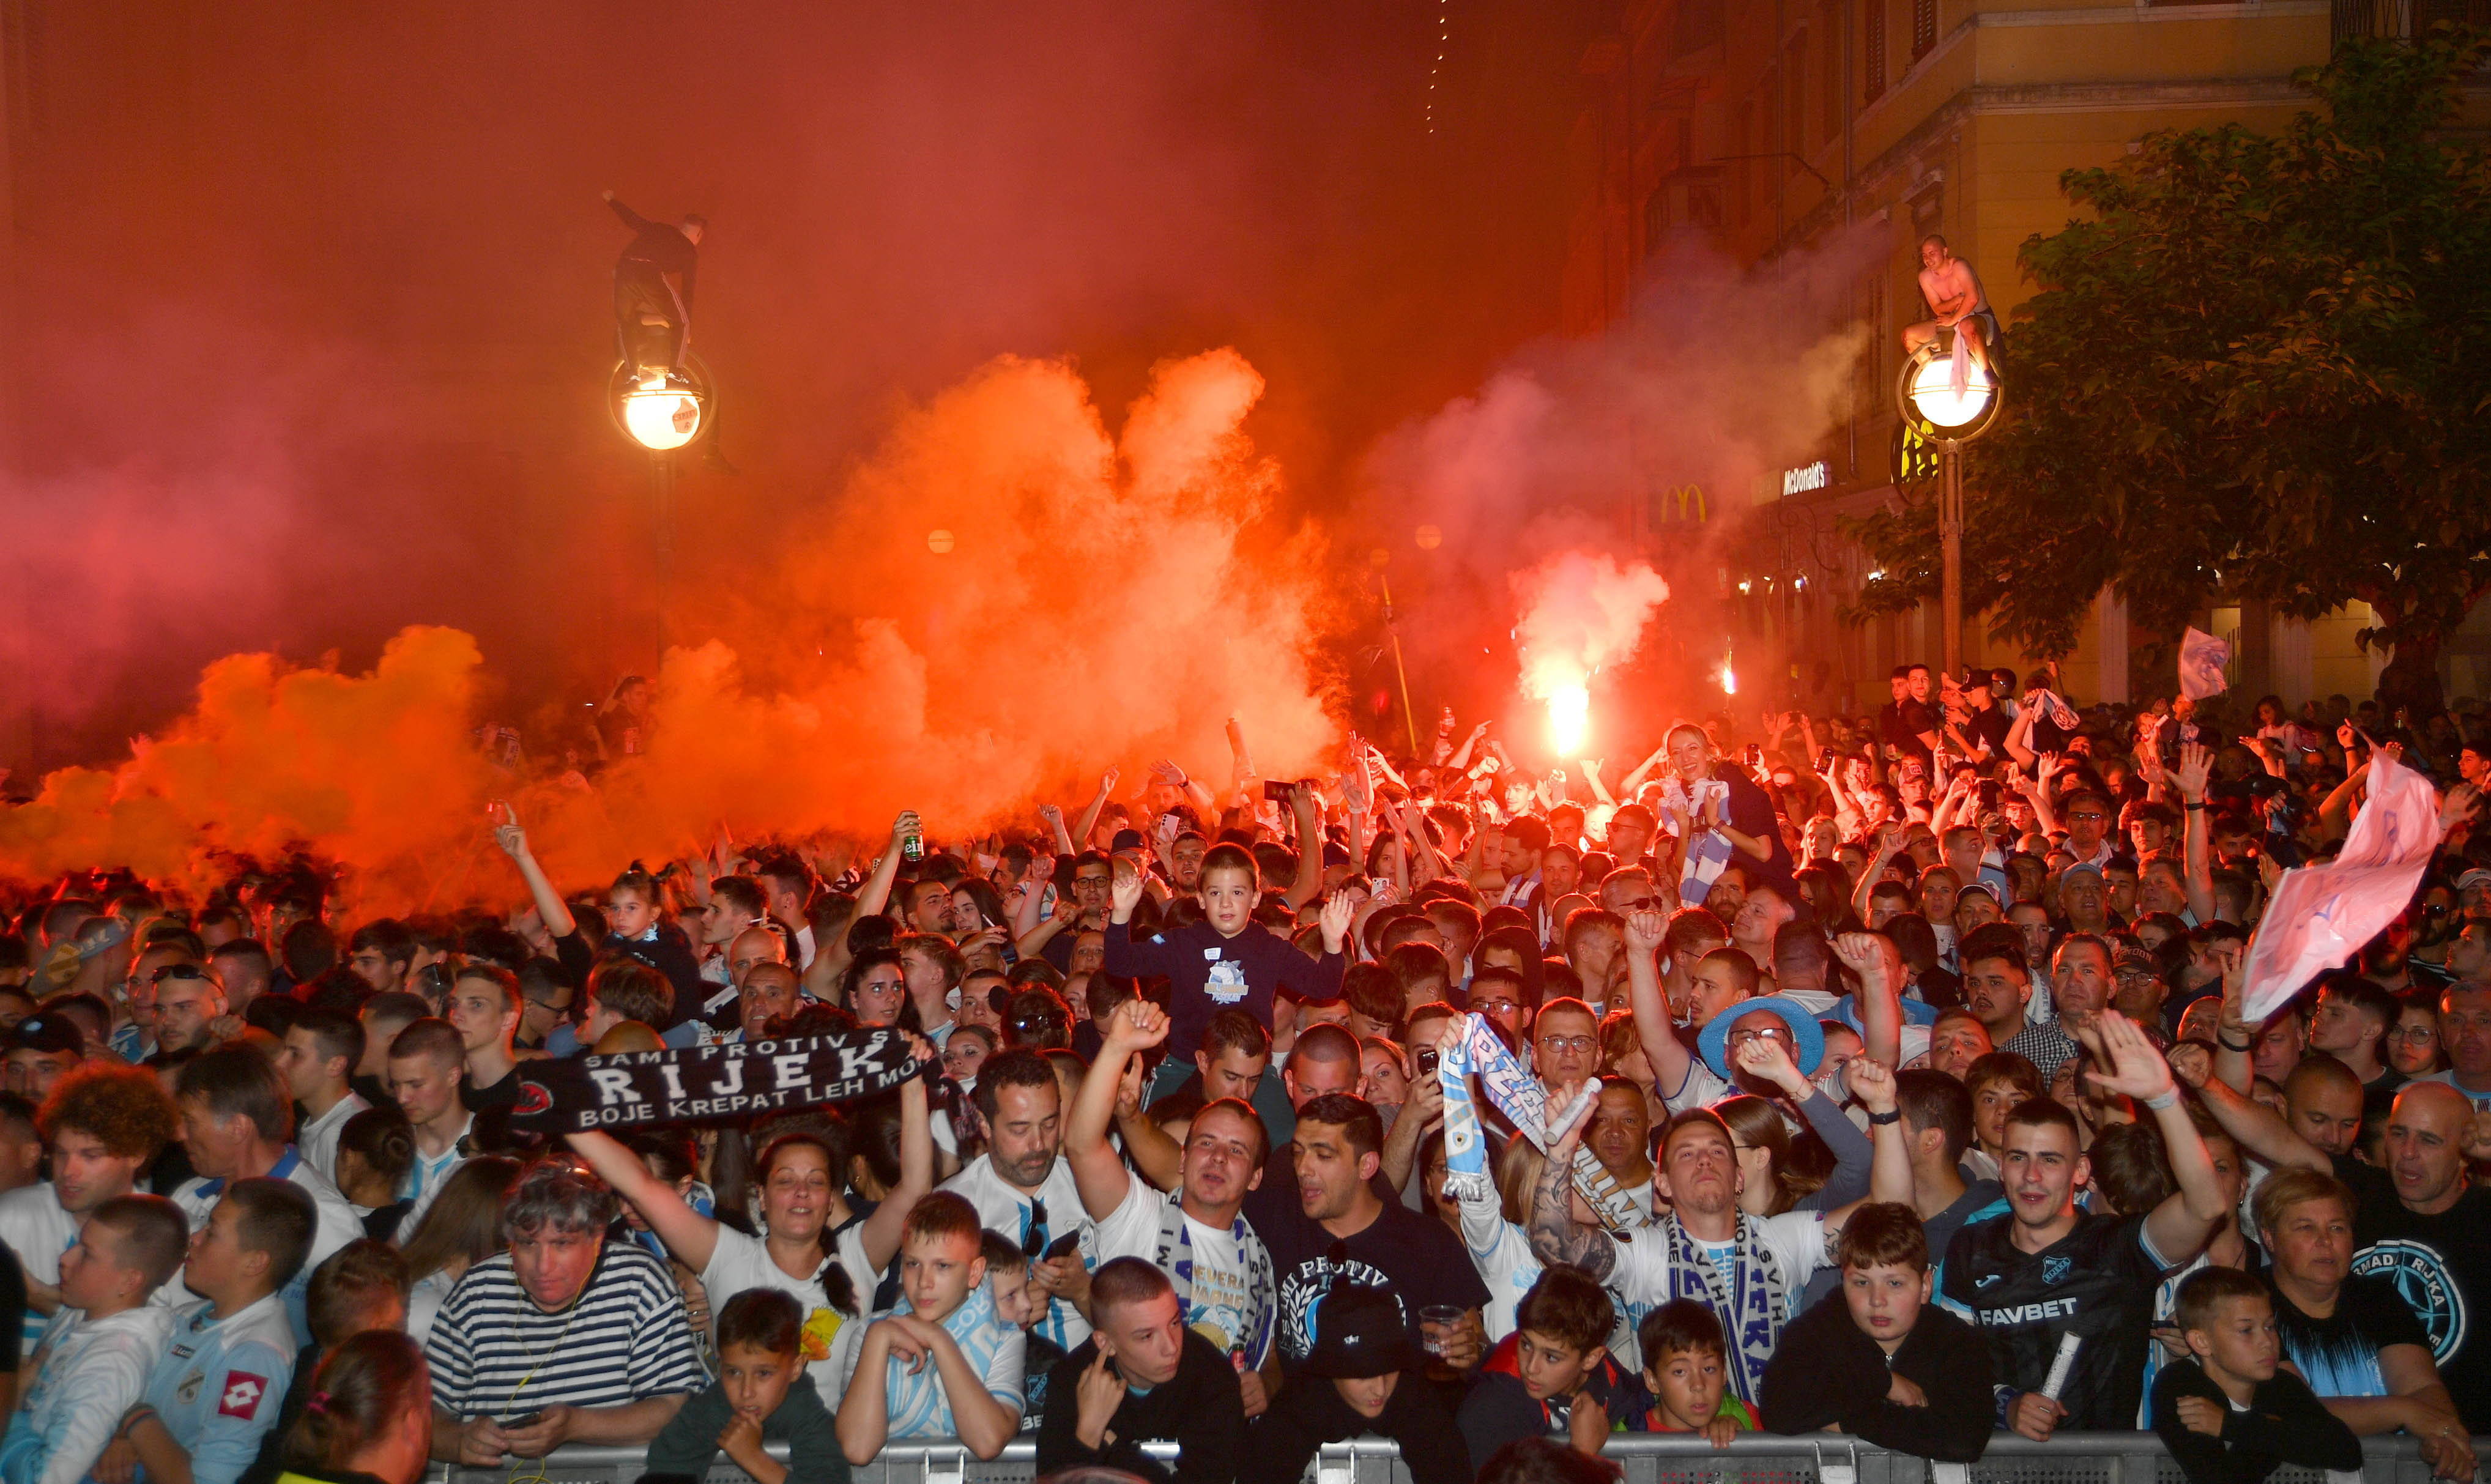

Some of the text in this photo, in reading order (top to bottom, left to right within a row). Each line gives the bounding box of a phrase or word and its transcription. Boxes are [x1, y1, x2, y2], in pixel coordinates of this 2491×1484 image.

[1783, 461, 1825, 496] McDonald's
[584, 1050, 678, 1068] SAMI
[702, 1033, 848, 1061] PROTIV
[588, 1042, 885, 1106] RIJEK
[579, 1104, 656, 1127] BOJE
[668, 1091, 789, 1118] KREPAT
[804, 1078, 864, 1102] LEH
[1759, 1250, 1783, 1326] SVIH
[1979, 1297, 2077, 1326] FAVBET
